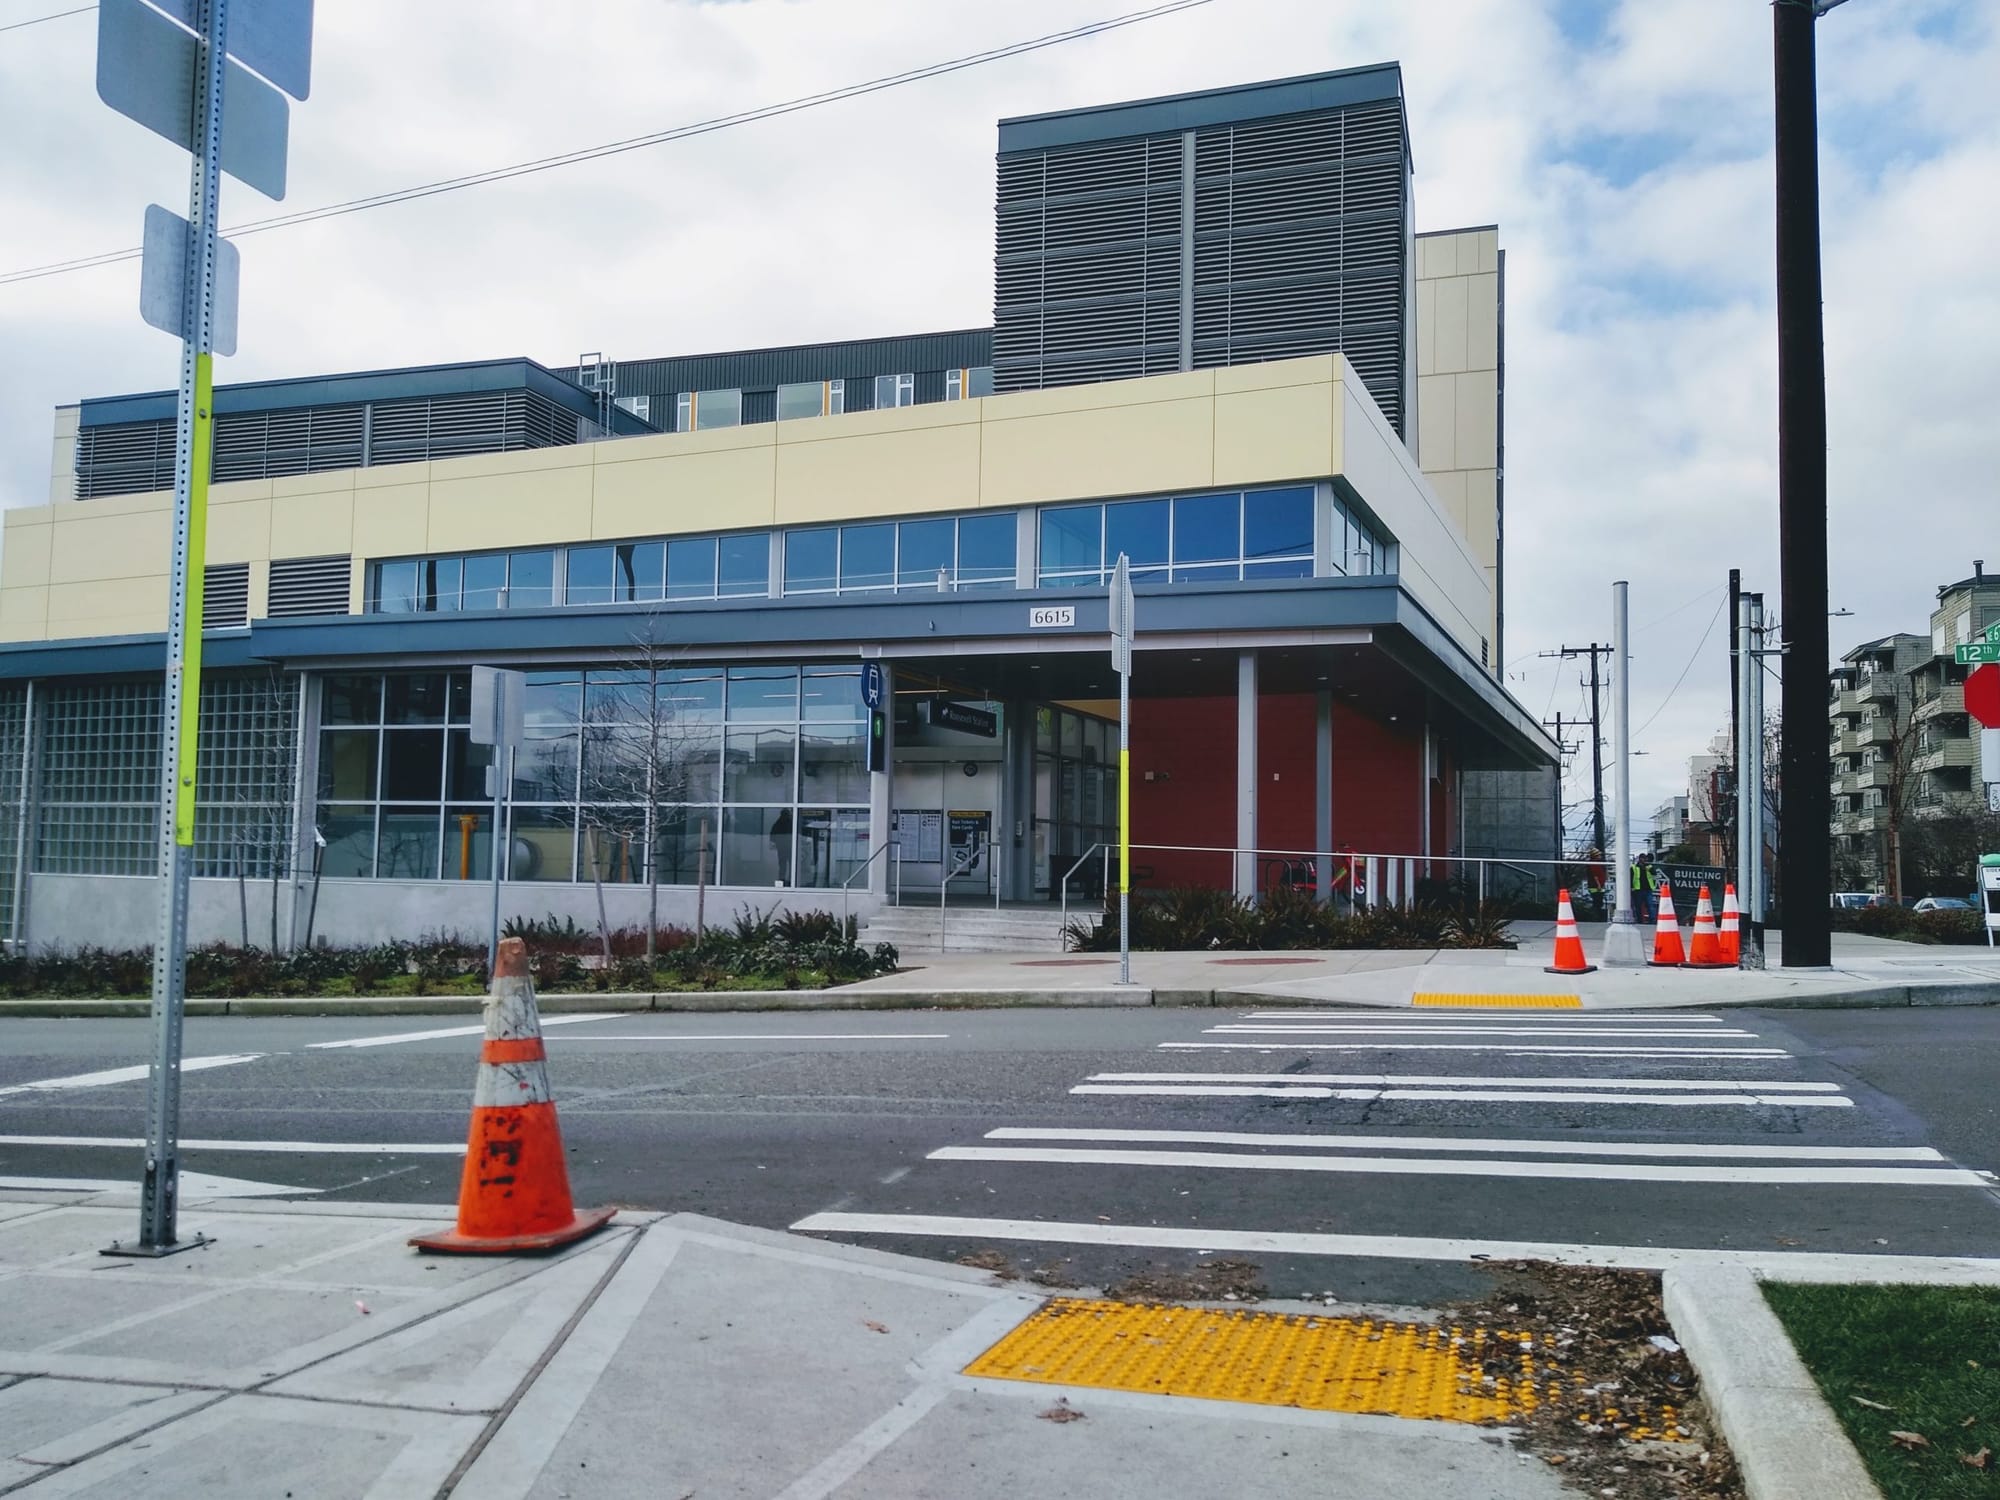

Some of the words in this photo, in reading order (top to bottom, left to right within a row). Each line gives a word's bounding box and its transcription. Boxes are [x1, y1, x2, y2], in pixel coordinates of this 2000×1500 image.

[1035, 610, 1070, 624] 6615
[1961, 645, 1993, 661] 12th
[1674, 870, 1721, 880] BUILDING
